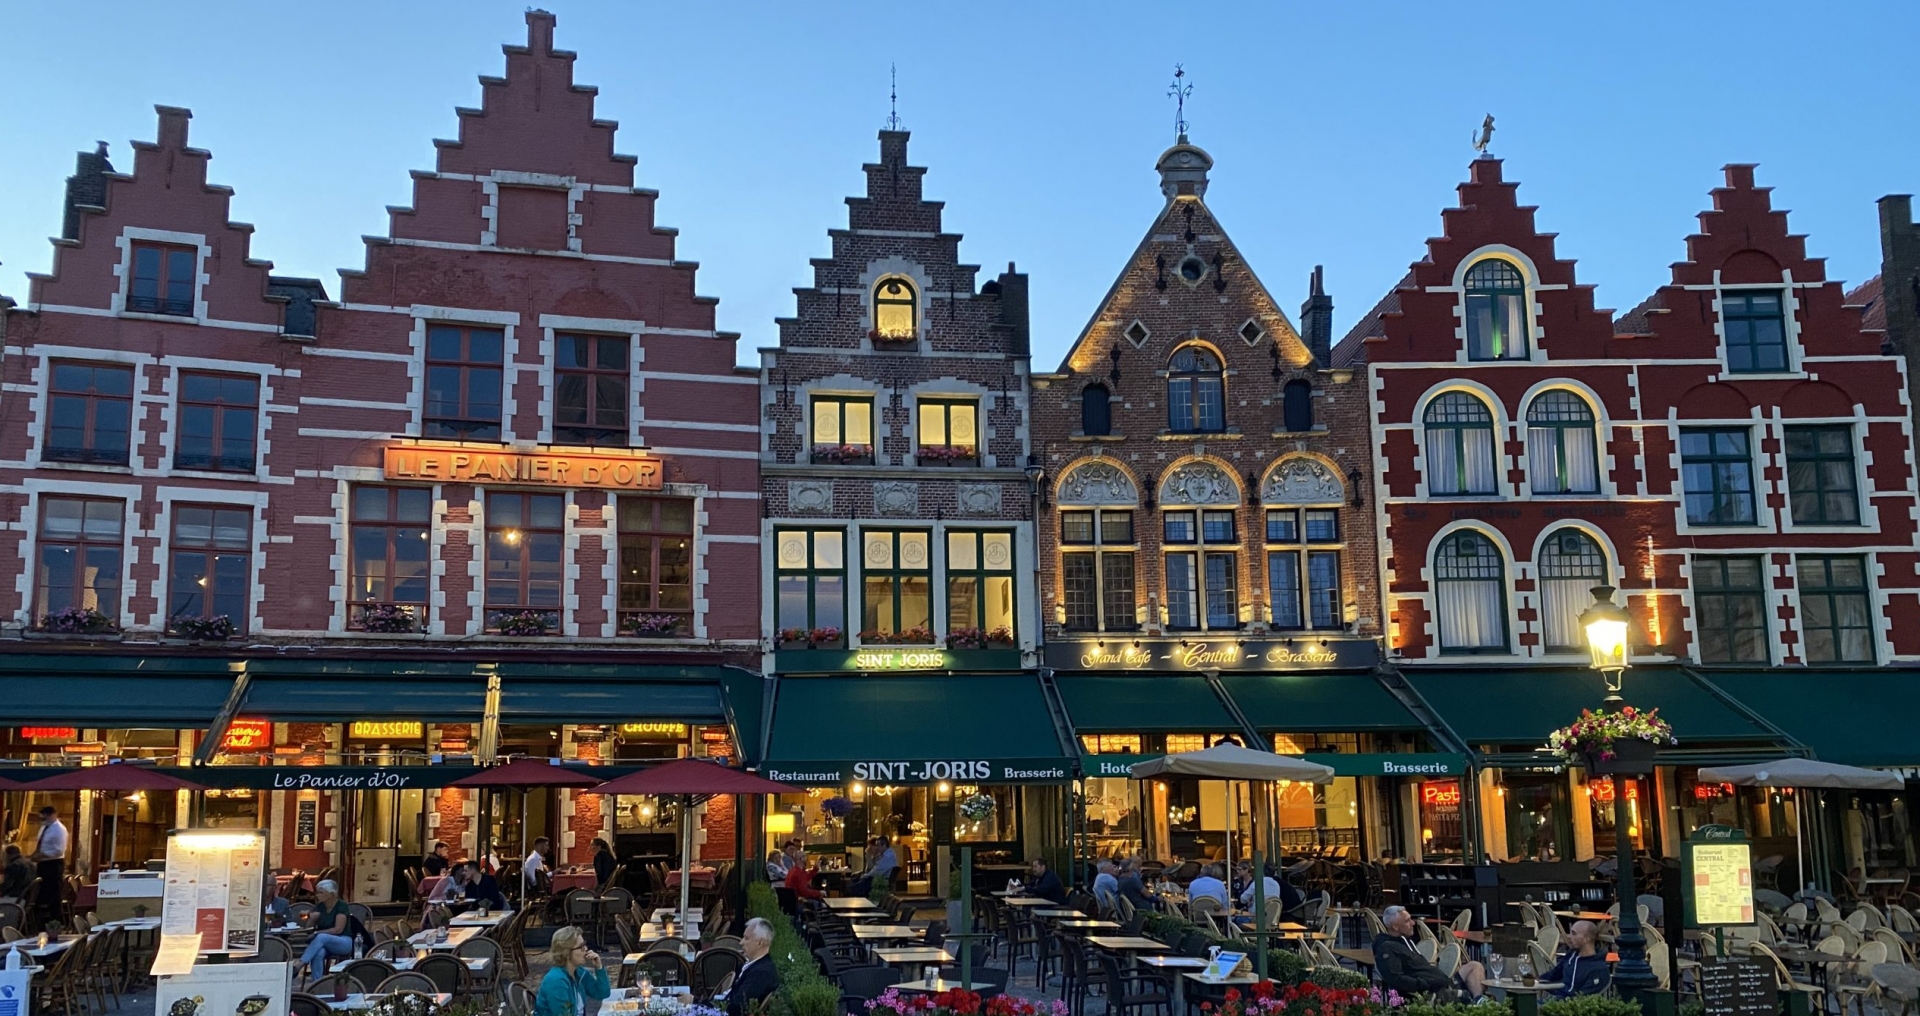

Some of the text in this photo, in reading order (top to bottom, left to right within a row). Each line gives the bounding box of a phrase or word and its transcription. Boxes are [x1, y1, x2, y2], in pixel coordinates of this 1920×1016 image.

[397, 454, 655, 486] LE PANIER D'OR
[856, 653, 944, 668] SINT JORIS
[1081, 650, 1122, 668] Grand
[1182, 642, 1239, 668] Central
[1266, 648, 1337, 663] Brasserie
[355, 721, 421, 735] BRASSERIE
[624, 723, 684, 732] CHOUFFE
[769, 761, 1064, 781] Restaurant SINT-JORIS Brasserie
[1100, 761, 1448, 774] Hote Brasserie
[275, 773, 297, 787] Le
[299, 773, 364, 787] Panier
[1425, 787, 1460, 802] Past
[1600, 784, 1637, 798] Pia
